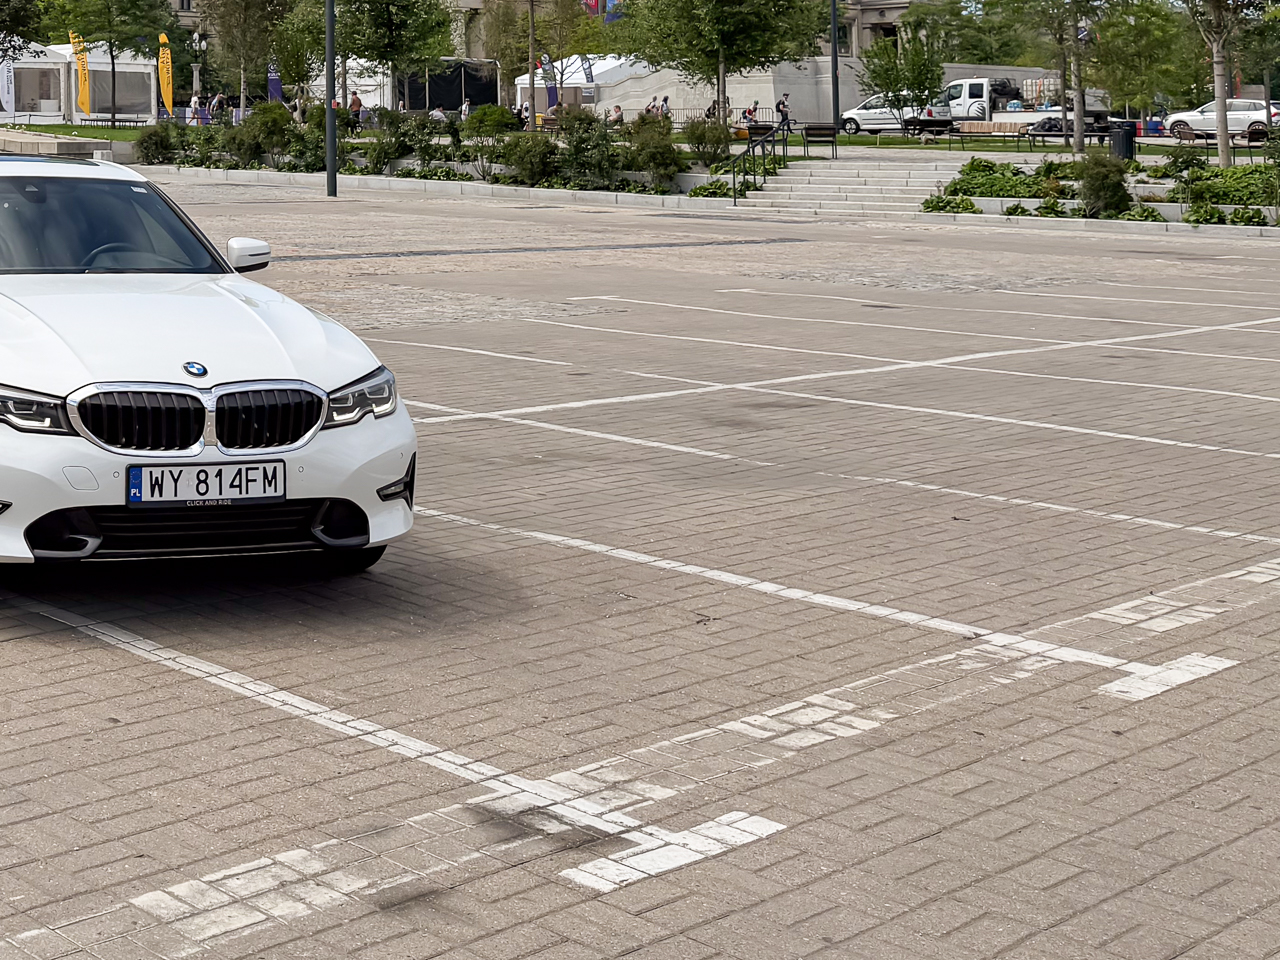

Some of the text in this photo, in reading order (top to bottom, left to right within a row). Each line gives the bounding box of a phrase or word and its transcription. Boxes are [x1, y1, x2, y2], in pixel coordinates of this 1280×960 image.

[149, 466, 278, 498] WY 814FM
[130, 488, 141, 497] PL
